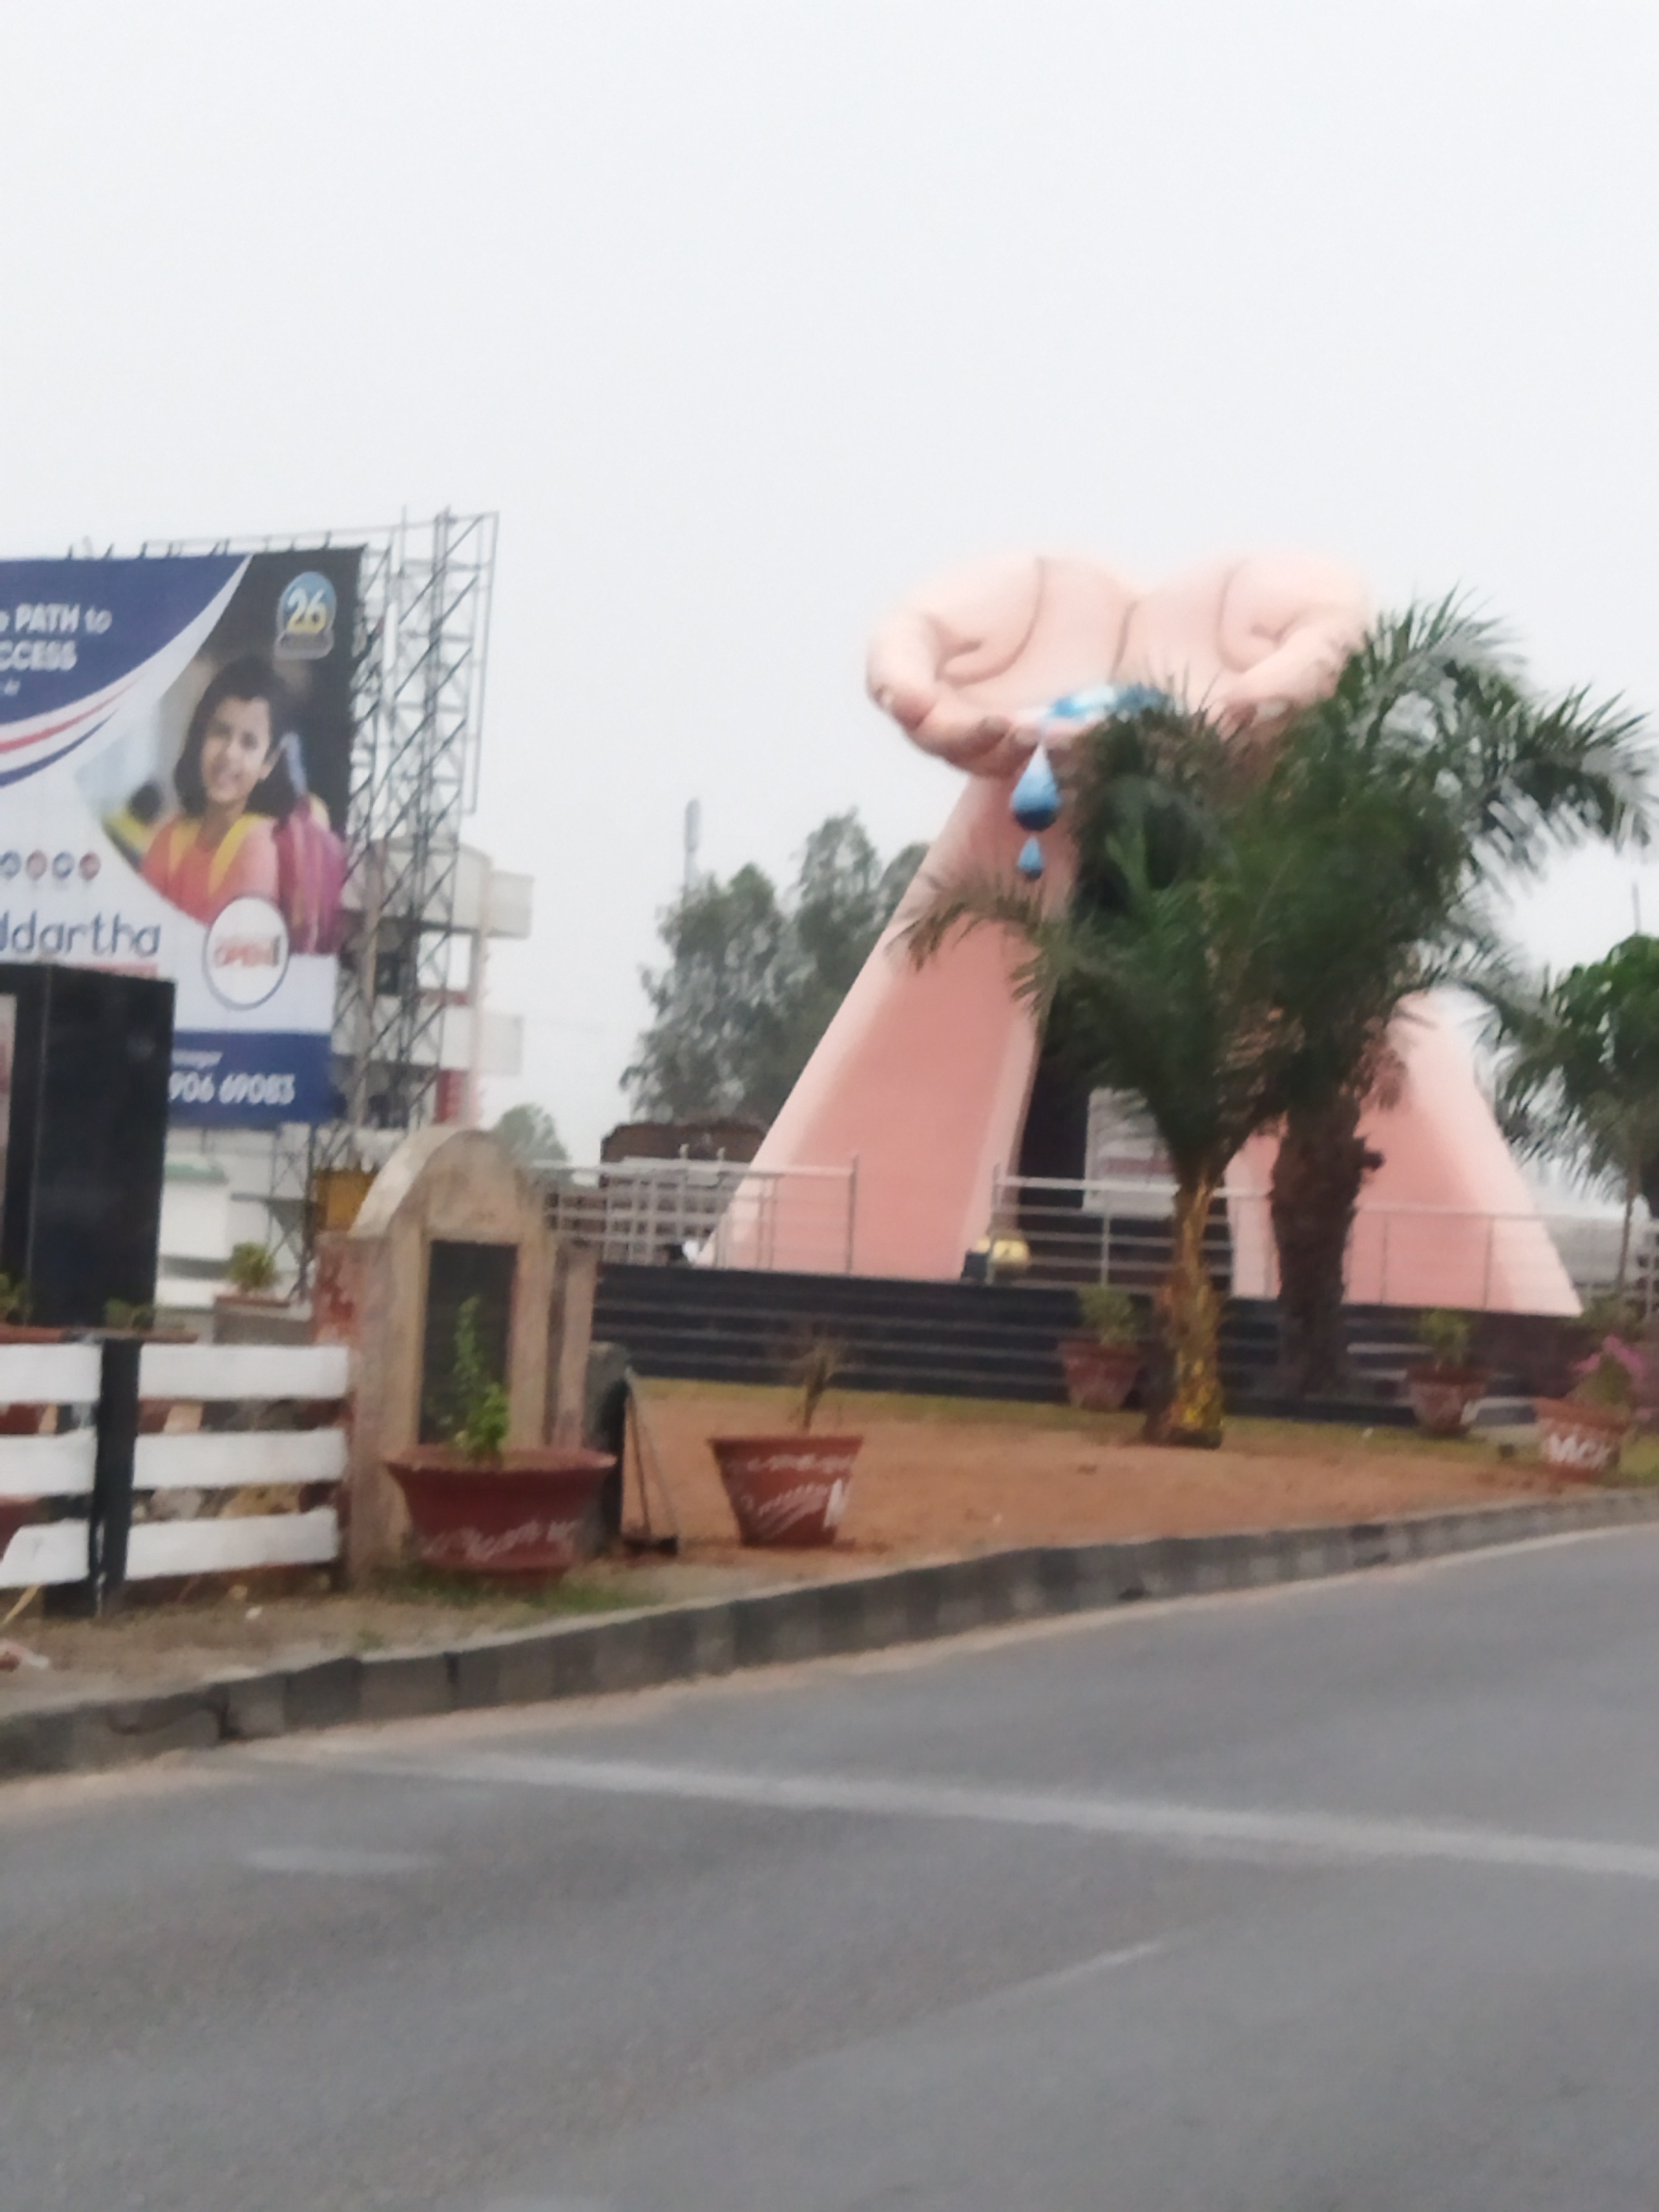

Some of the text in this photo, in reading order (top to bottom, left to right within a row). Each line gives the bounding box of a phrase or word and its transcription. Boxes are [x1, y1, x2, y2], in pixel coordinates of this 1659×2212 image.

[15, 603, 80, 633] PATH
[85, 606, 112, 634] to
[286, 588, 326, 633] 26
